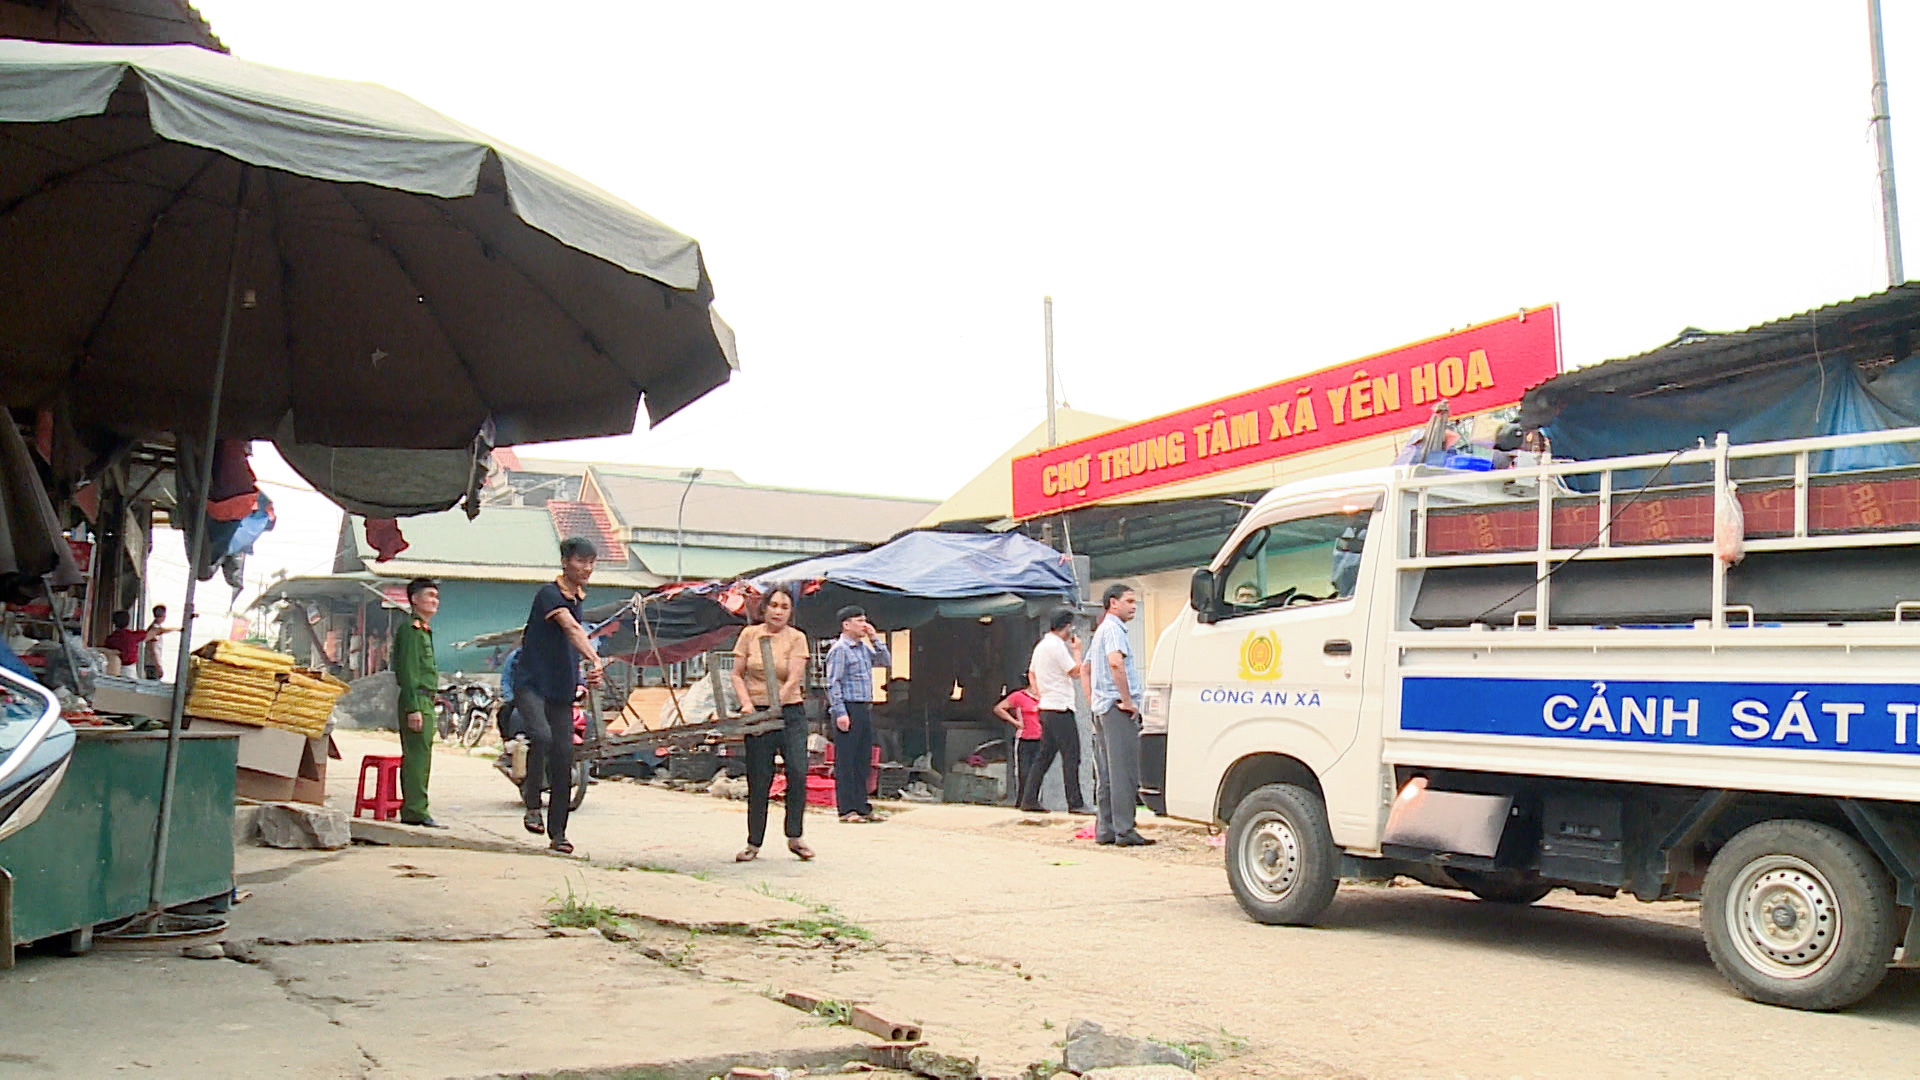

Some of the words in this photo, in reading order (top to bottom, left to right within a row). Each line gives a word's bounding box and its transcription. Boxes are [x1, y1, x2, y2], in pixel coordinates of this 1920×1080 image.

[1043, 453, 1091, 496] CHỢ
[1098, 431, 1186, 483] TRUNG
[1193, 409, 1260, 458] TÂM
[1268, 385, 1318, 441] XÃ
[1327, 369, 1400, 424] YÊN
[1410, 349, 1494, 405] HOA
[1200, 685, 1254, 704] CÔNG
[1260, 691, 1288, 705] AN
[1294, 689, 1321, 707] XÃ
[1542, 682, 1699, 737] CẢNH
[1730, 690, 1865, 744] SÁT
[1886, 703, 1920, 746] T
